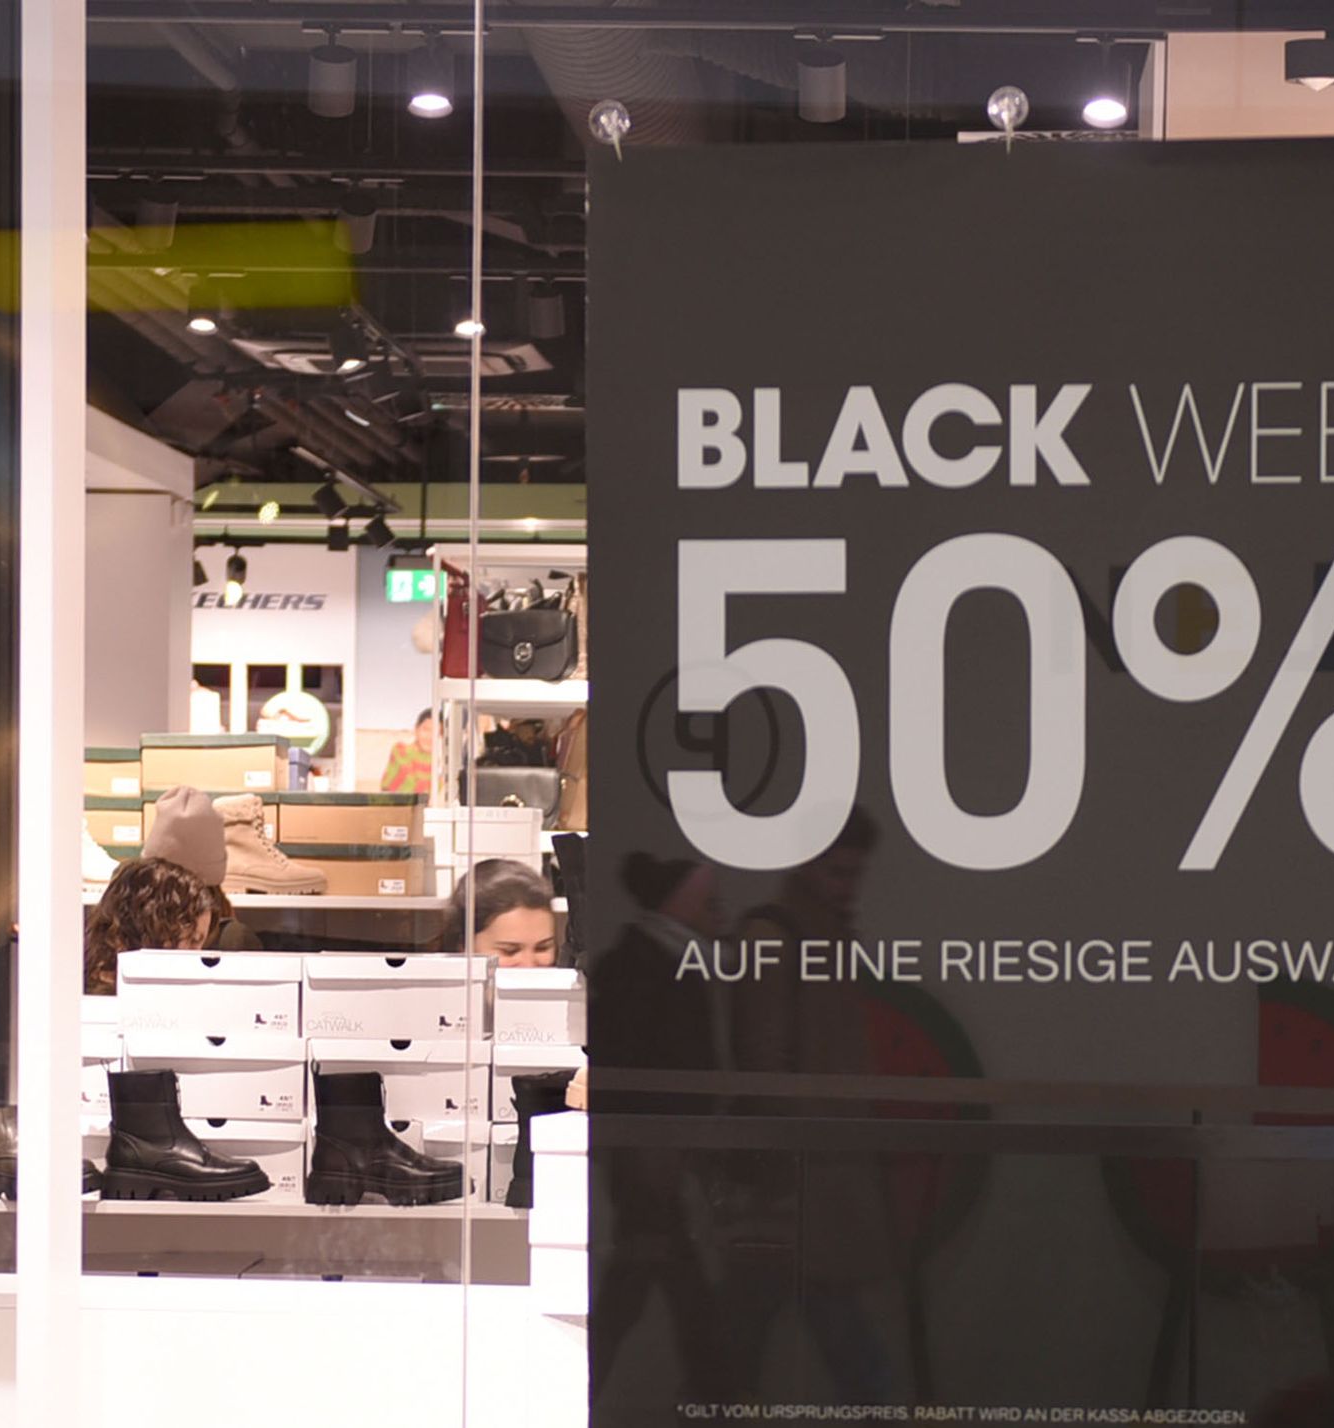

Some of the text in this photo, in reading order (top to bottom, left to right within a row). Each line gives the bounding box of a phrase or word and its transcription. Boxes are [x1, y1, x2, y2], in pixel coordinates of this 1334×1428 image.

[677, 383, 1093, 489] BLACK
[675, 940, 782, 981] AUF
[801, 940, 922, 981] EINE
[941, 940, 1152, 982] RIESIGE
[306, 1018, 364, 1032] CATWALK
[497, 1029, 556, 1042] CATWALK
[722, 1404, 760, 1419] VOM
[914, 1406, 975, 1421] RABATT
[978, 1407, 1022, 1422] WIRD
[1023, 1407, 1048, 1422] AN
[1050, 1407, 1085, 1422] DER
[1087, 1408, 1140, 1423] KASSA
